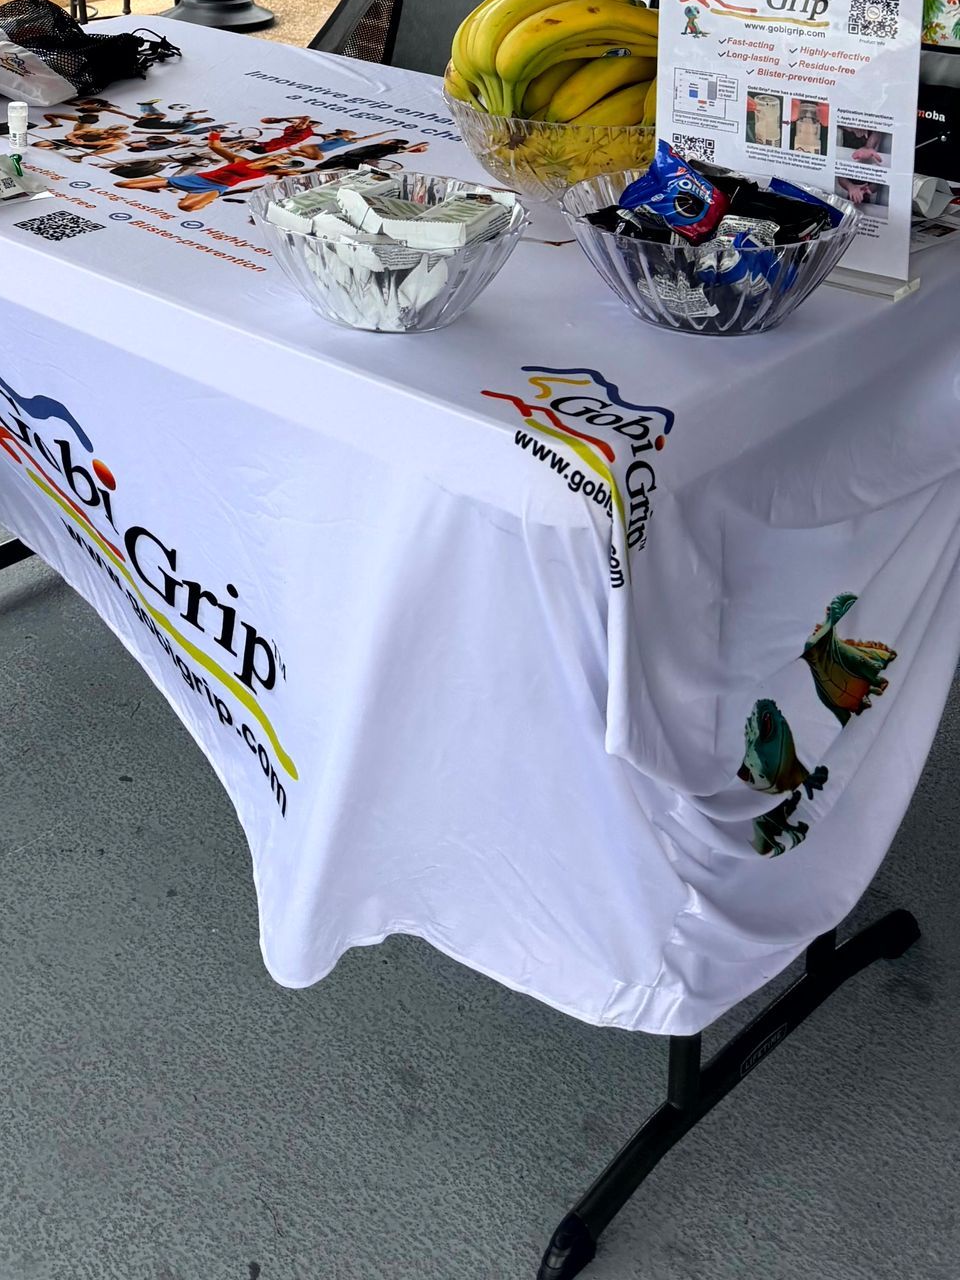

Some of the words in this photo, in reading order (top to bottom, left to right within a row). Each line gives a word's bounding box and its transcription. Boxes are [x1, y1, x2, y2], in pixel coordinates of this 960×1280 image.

[744, 22, 826, 38] www.gobigrip.com
[727, 37, 775, 51] Fast-acting
[726, 50, 780, 65] Long-lasting
[800, 46, 871, 63] Highly-effective
[798, 60, 856, 76] Residue-free
[757, 68, 836, 86] Blister-prevention
[244, 70, 348, 99] Innovative
[345, 96, 393, 110] grip
[303, 97, 352, 114] total
[349, 111, 419, 130] game
[89, 187, 179, 220] Long-lasting
[128, 219, 268, 272] Blister-prevention
